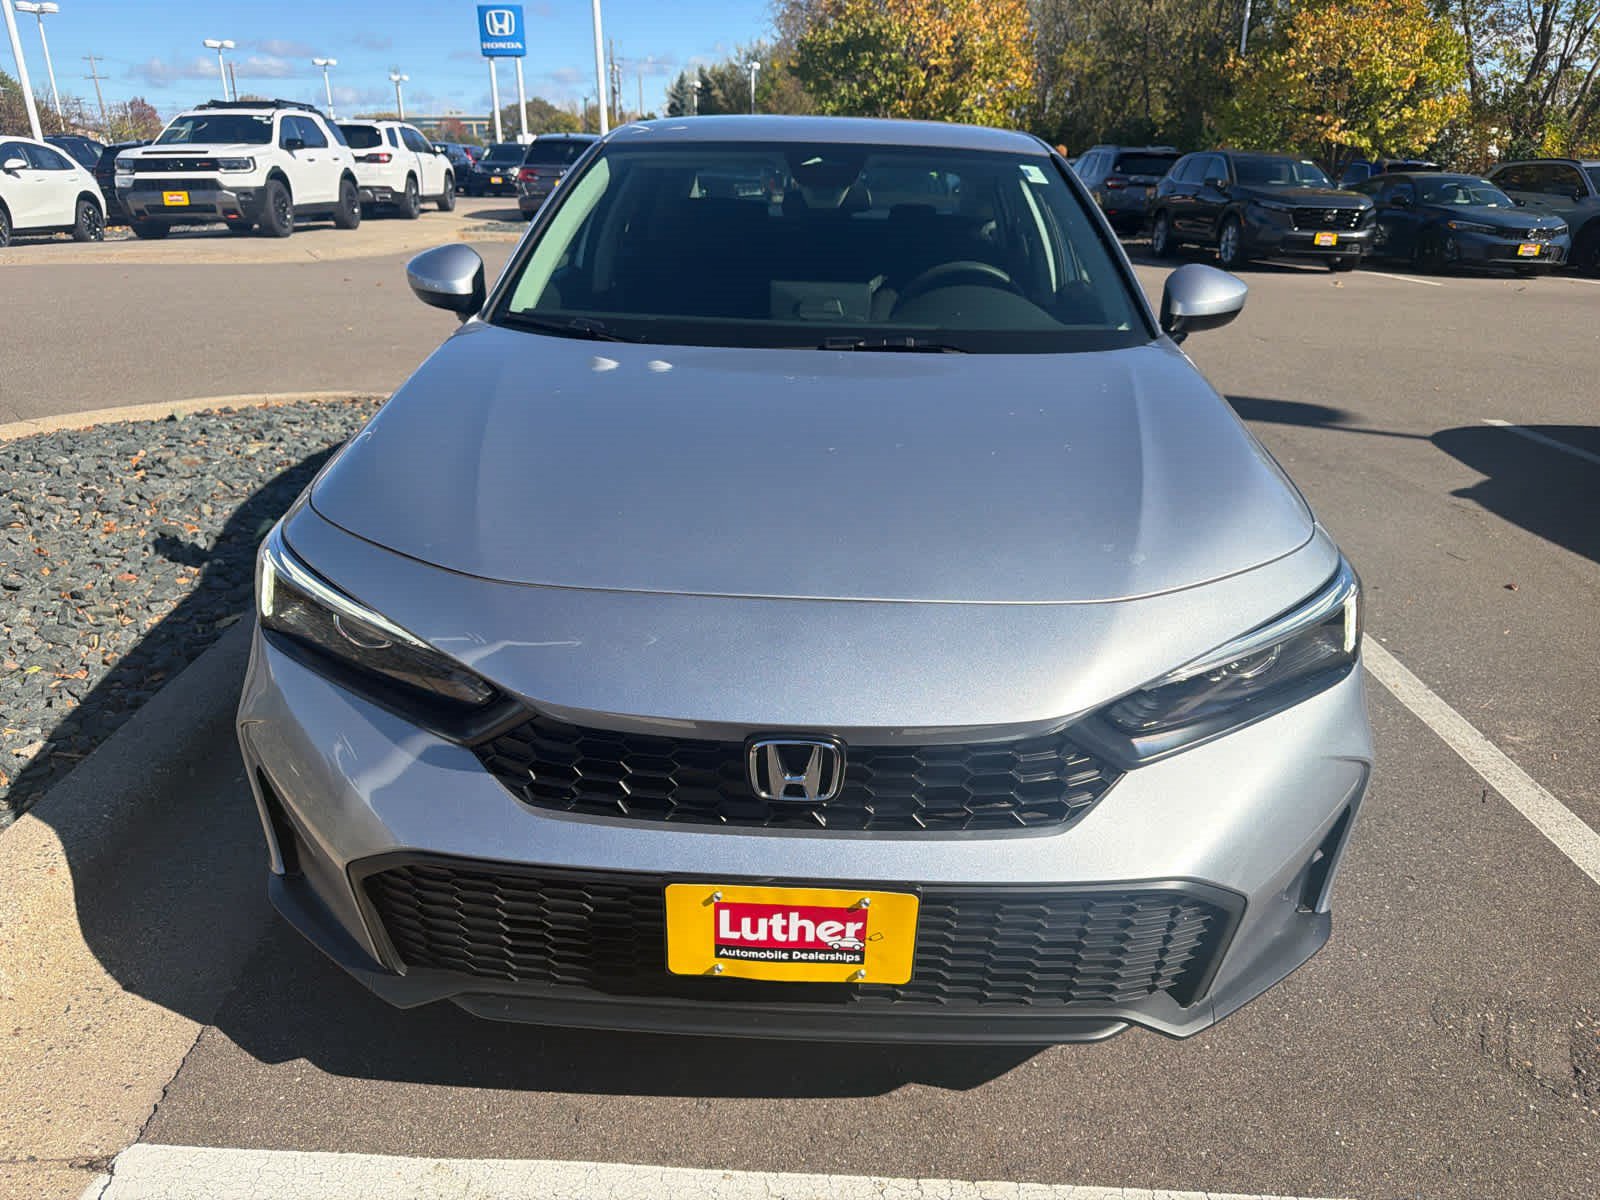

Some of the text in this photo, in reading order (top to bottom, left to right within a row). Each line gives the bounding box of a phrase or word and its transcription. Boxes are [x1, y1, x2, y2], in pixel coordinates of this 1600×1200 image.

[719, 909, 863, 943] Luther
[719, 948, 861, 963] Automobile Dealerships
